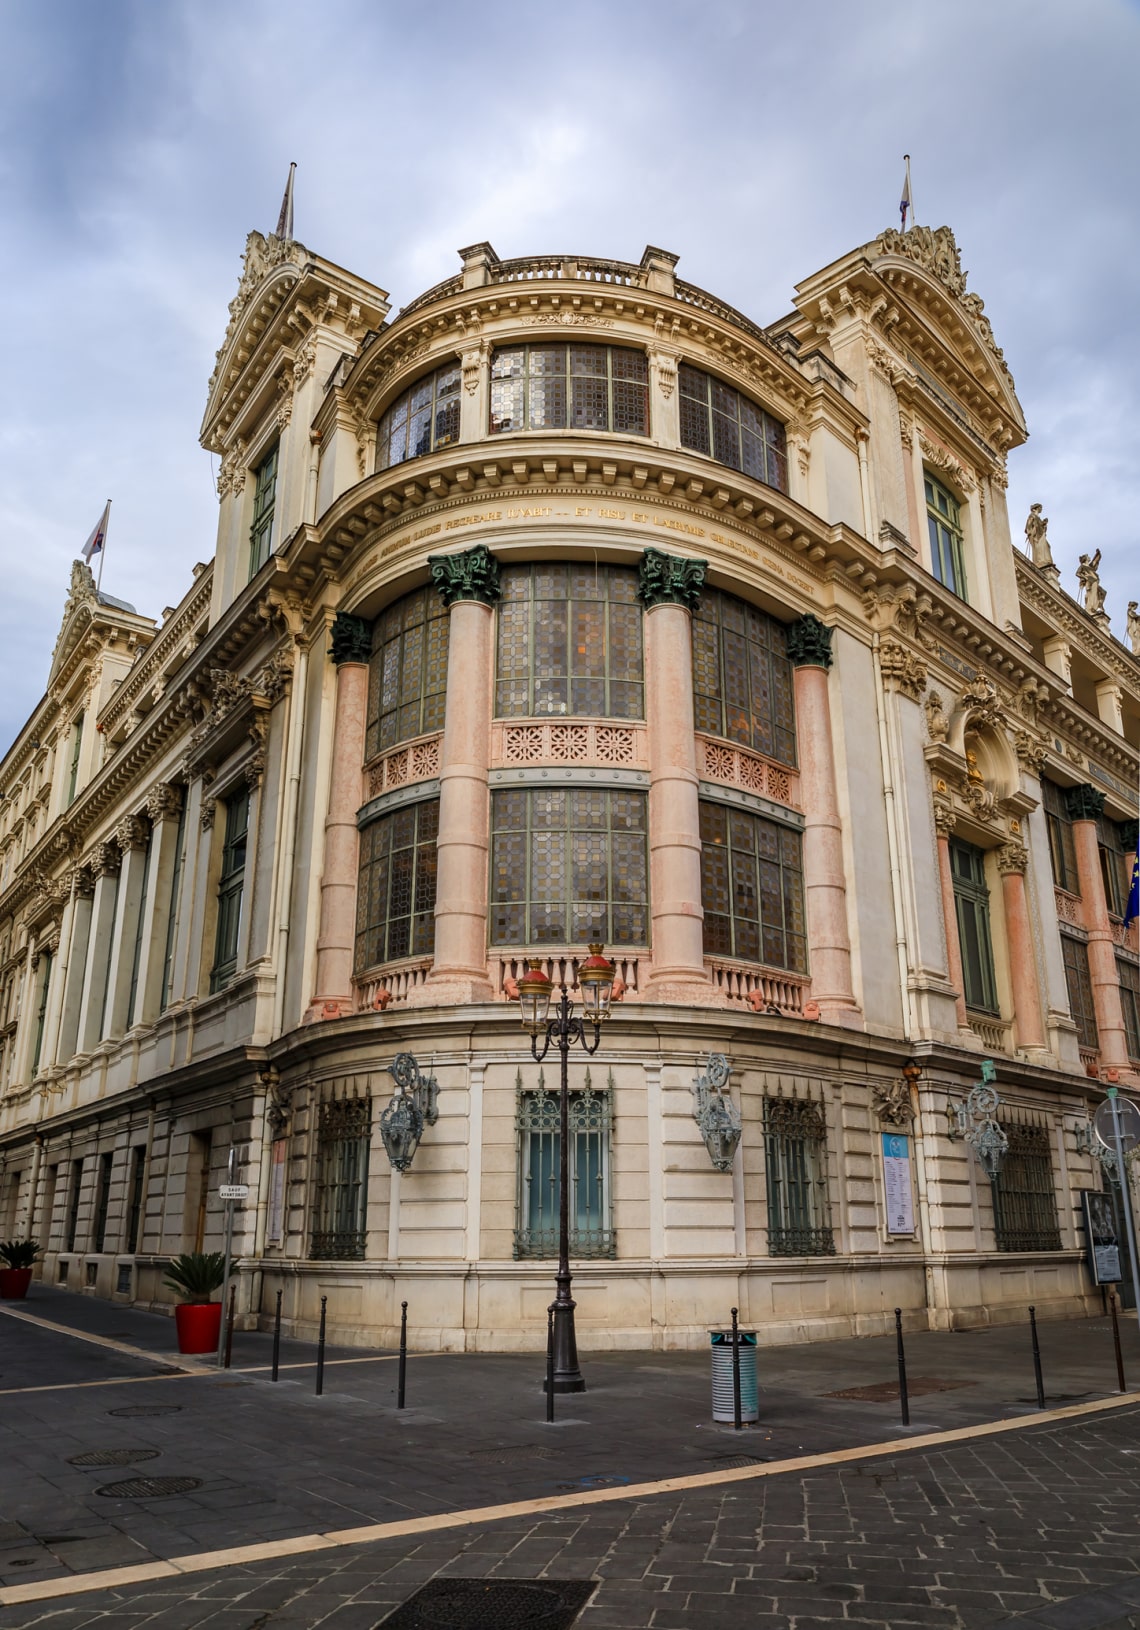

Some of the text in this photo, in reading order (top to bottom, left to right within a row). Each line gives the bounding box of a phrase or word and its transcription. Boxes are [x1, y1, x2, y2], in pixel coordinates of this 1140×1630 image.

[446, 513, 502, 530] RECREARE
[575, 507, 592, 516] ET
[598, 508, 626, 520] RISU
[632, 512, 649, 523] ET
